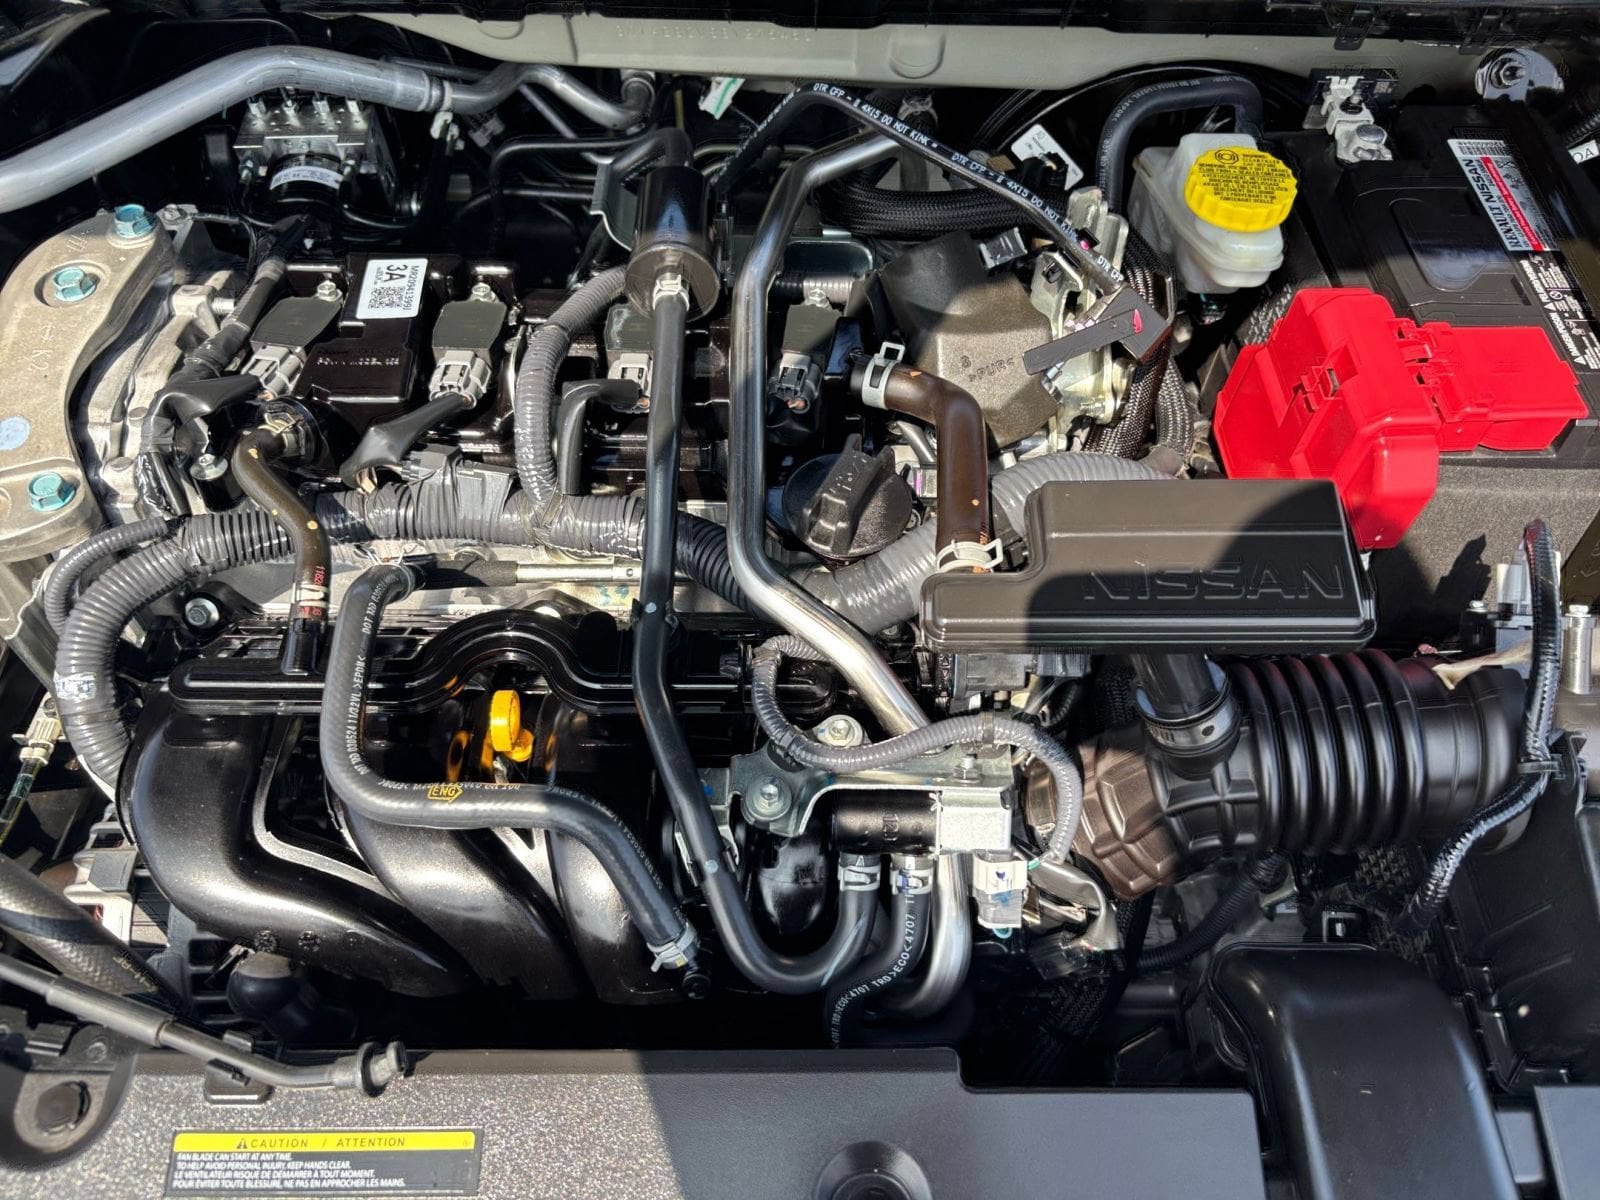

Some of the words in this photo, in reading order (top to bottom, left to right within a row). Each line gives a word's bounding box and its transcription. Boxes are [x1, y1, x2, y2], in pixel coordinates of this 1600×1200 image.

[879, 113, 893, 125] DO
[892, 120, 909, 134] NOT
[908, 128, 931, 146] KINK
[1462, 159, 1497, 203] NISSAN
[1029, 195, 1043, 208] DO
[1042, 206, 1060, 221] NOT
[1487, 205, 1522, 248] RENAULT
[1094, 254, 1113, 272] DTR
[384, 264, 408, 282] 3A
[1084, 561, 1345, 599] NISSAN
[362, 615, 372, 634] DOT
[346, 725, 357, 751] 030524
[431, 784, 456, 795] ENG
[250, 1138, 308, 1148] CAUTION
[336, 1137, 405, 1147] ATTENTION
[176, 1161, 185, 1169] TO
[186, 1161, 204, 1169] HELP
[204, 1161, 225, 1169] AVOID
[226, 1161, 260, 1169] PERSONAL
[286, 1160, 303, 1169] KEEP
[304, 1160, 328, 1168] HANDS
[229, 1152, 250, 1160] START
[250, 1152, 259, 1160] AT
[260, 1152, 275, 1160] ANY
[172, 1179, 193, 1188] POUR
[221, 1179, 244, 1188] TOUTE
[283, 1178, 294, 1188] NE
[295, 1178, 308, 1188] PAS
[310, 1178, 320, 1188] EN
[320, 1178, 364, 1188] APPROCHER
[366, 1178, 378, 1186] LES
[174, 1170, 183, 1179] LE
[183, 1170, 232, 1179] VENTILATEUR
[233, 1170, 259, 1178] RISQUE
[260, 1169, 271, 1178] DE
[319, 1169, 340, 1178] TOUT
